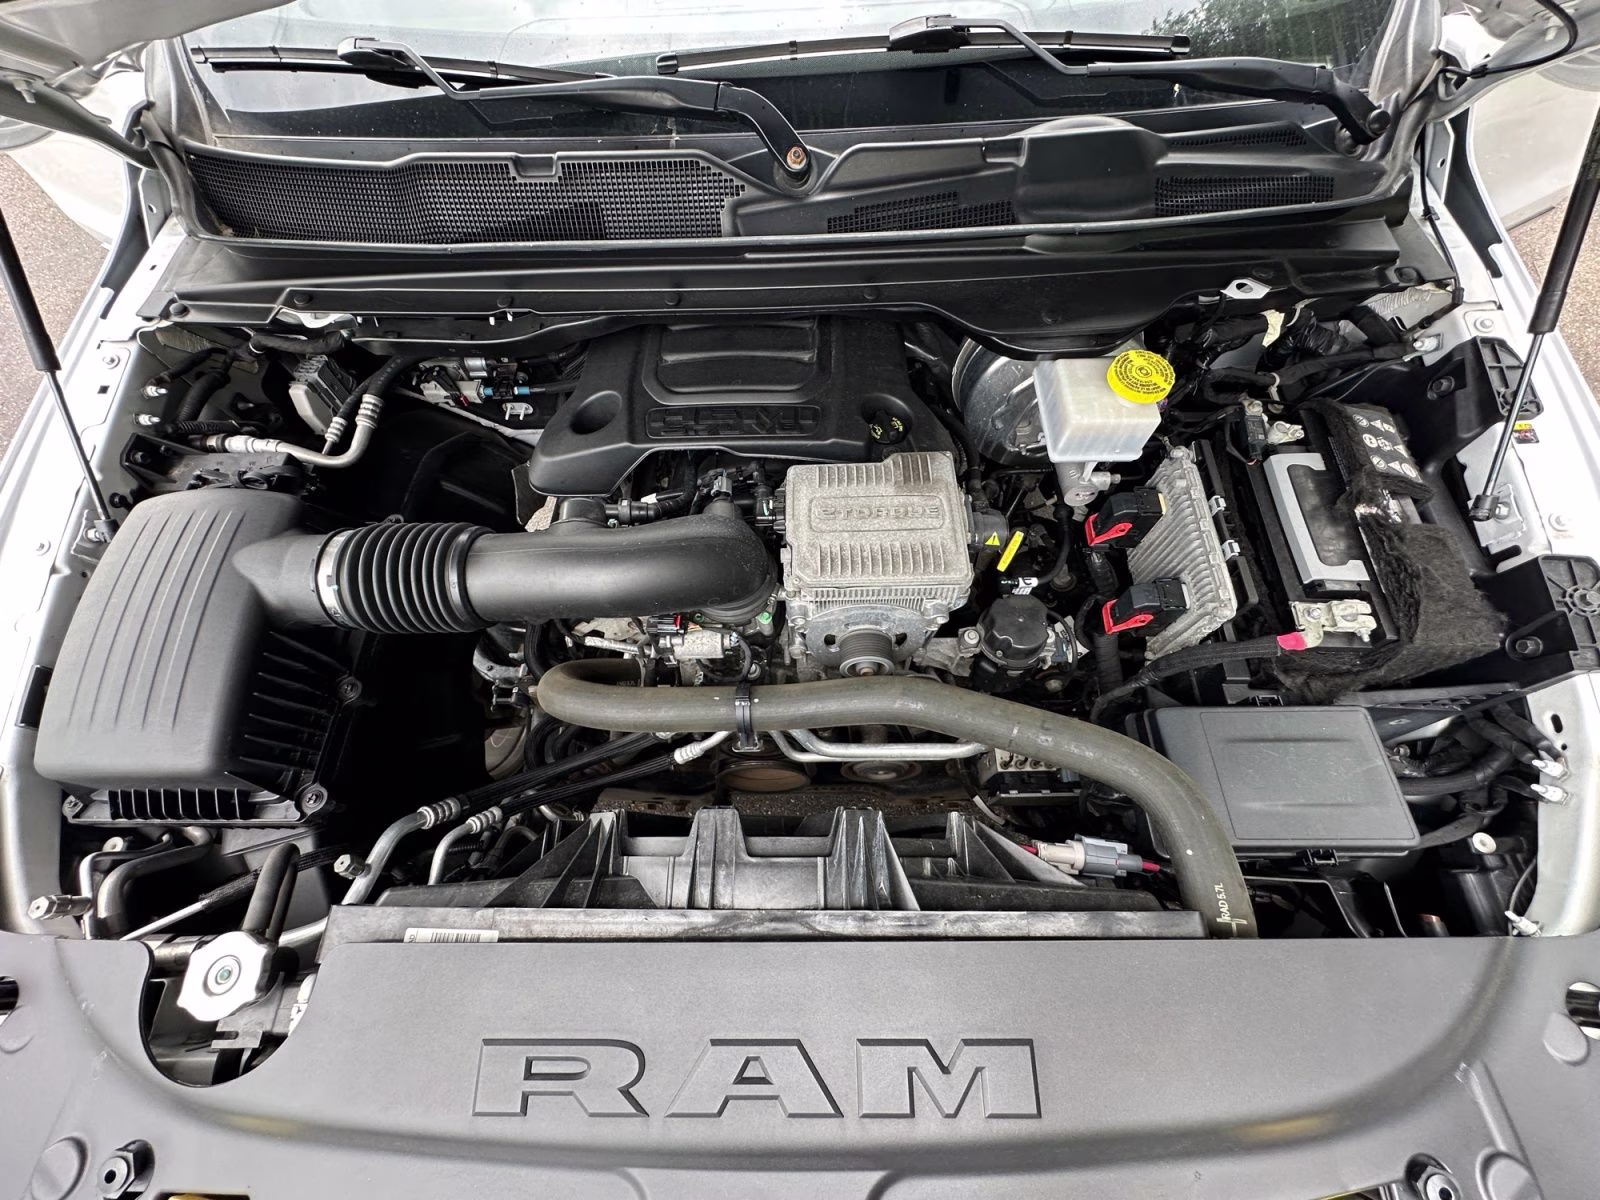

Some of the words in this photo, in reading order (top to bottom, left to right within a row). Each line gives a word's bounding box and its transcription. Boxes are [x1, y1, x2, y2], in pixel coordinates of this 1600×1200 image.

[1214, 882, 1226, 899] 5.7L
[1218, 900, 1231, 920] RAD
[472, 1038, 1042, 1118] RAM
